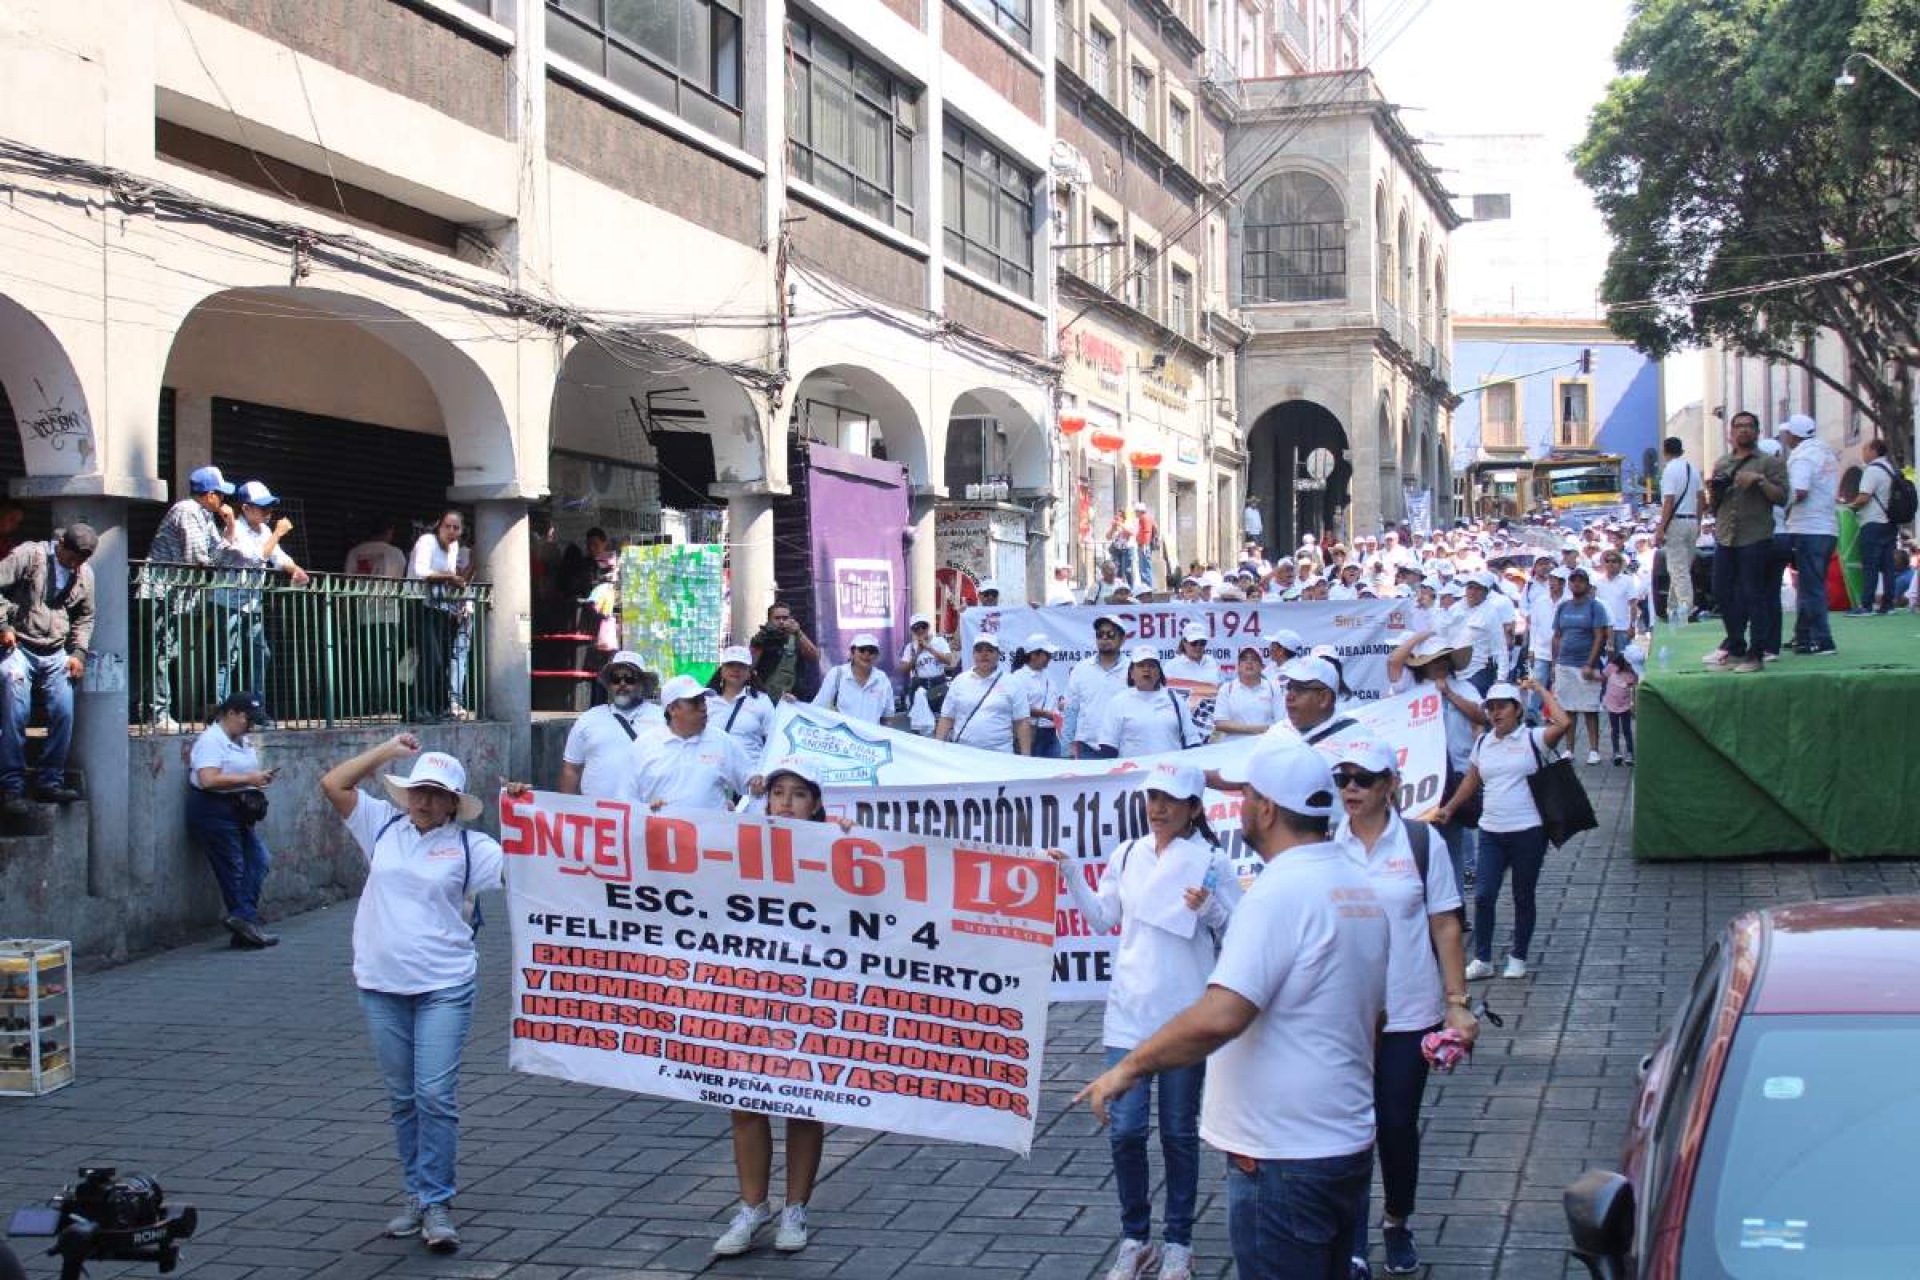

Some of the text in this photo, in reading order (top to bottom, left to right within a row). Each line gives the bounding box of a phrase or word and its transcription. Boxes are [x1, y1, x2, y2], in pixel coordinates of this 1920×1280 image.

[1205, 610, 1262, 638] 194
[1407, 694, 1440, 719] 19
[500, 791, 619, 867] SNTE
[1040, 790, 1150, 858] D-11-10
[605, 882, 940, 950] ESC. SEC. N° 4
[972, 861, 1040, 908] 19
[527, 912, 1021, 995] “FELIPE CARRILLO PUERTO”
[532, 943, 1024, 1032] EXIGIMOS PAGOS DE ADEUDOS
[1051, 950, 1113, 982] NTE
[521, 994, 1029, 1089] INGRESOS HORAS ADICIONALES
[522, 967, 548, 990] Y
[841, 1009, 889, 1037] DE
[892, 1017, 1030, 1061] NUEVOS
[513, 1017, 619, 1051] HORAS
[622, 1031, 663, 1058] DE
[665, 1038, 814, 1083] RUBRICA
[818, 1061, 846, 1086] Y
[658, 1064, 872, 1108] F. JAVIER PEÑA GUERRERO
[698, 1088, 817, 1119] SRIO GENERAL
